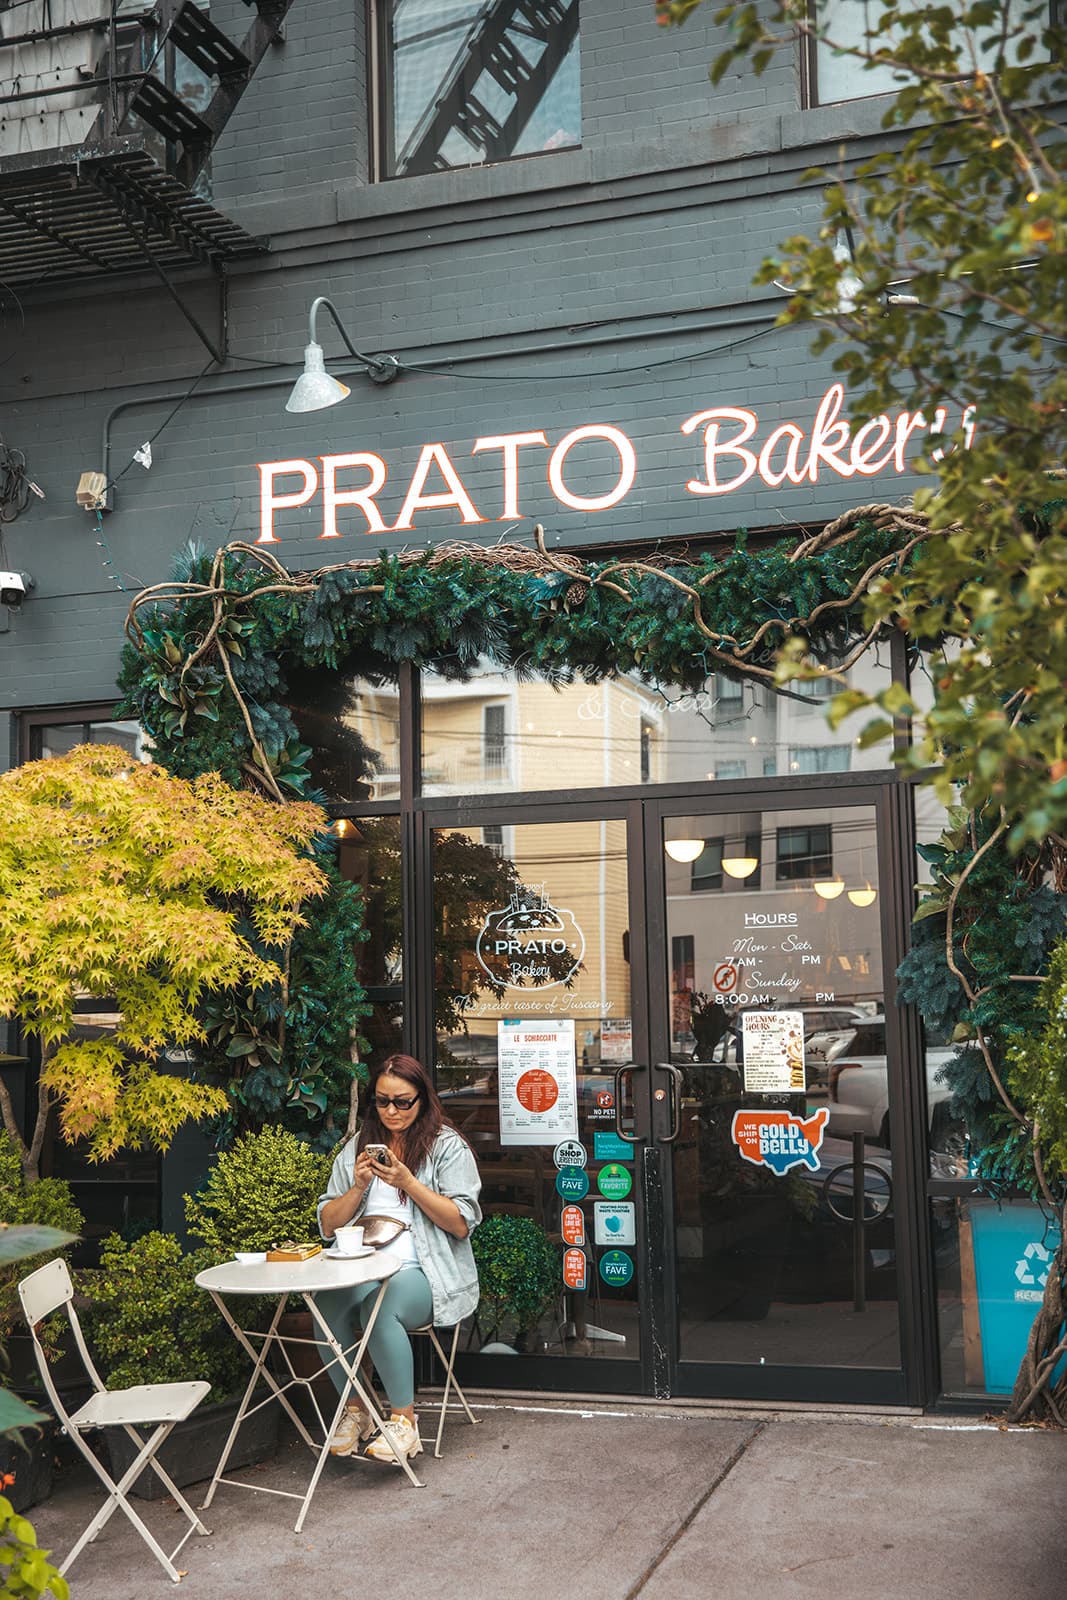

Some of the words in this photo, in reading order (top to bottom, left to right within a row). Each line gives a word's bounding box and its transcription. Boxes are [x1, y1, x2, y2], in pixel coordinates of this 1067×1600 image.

[254, 423, 637, 544] PRATO
[495, 938, 567, 955] PRATO
[732, 936, 768, 953] Mon
[725, 956, 735, 967] 7
[737, 957, 756, 967] AM
[801, 955, 821, 965] PM
[744, 971, 802, 992] Sunday
[478, 1000, 511, 1017] great
[514, 1000, 543, 1010] taste
[545, 996, 558, 1014] of
[560, 992, 614, 1013] Tuscany
[715, 993, 749, 1005] 8:00
[750, 994, 770, 1004] AM
[815, 992, 835, 1002] PM
[745, 1015, 777, 1023] OPENING
[745, 1023, 770, 1031] HOURS
[514, 1034, 520, 1042] LE
[758, 1123, 800, 1139] GOLD
[559, 1150, 582, 1158] SHOP
[562, 1181, 583, 1190] FAVE
[605, 1266, 627, 1275] FAVE
